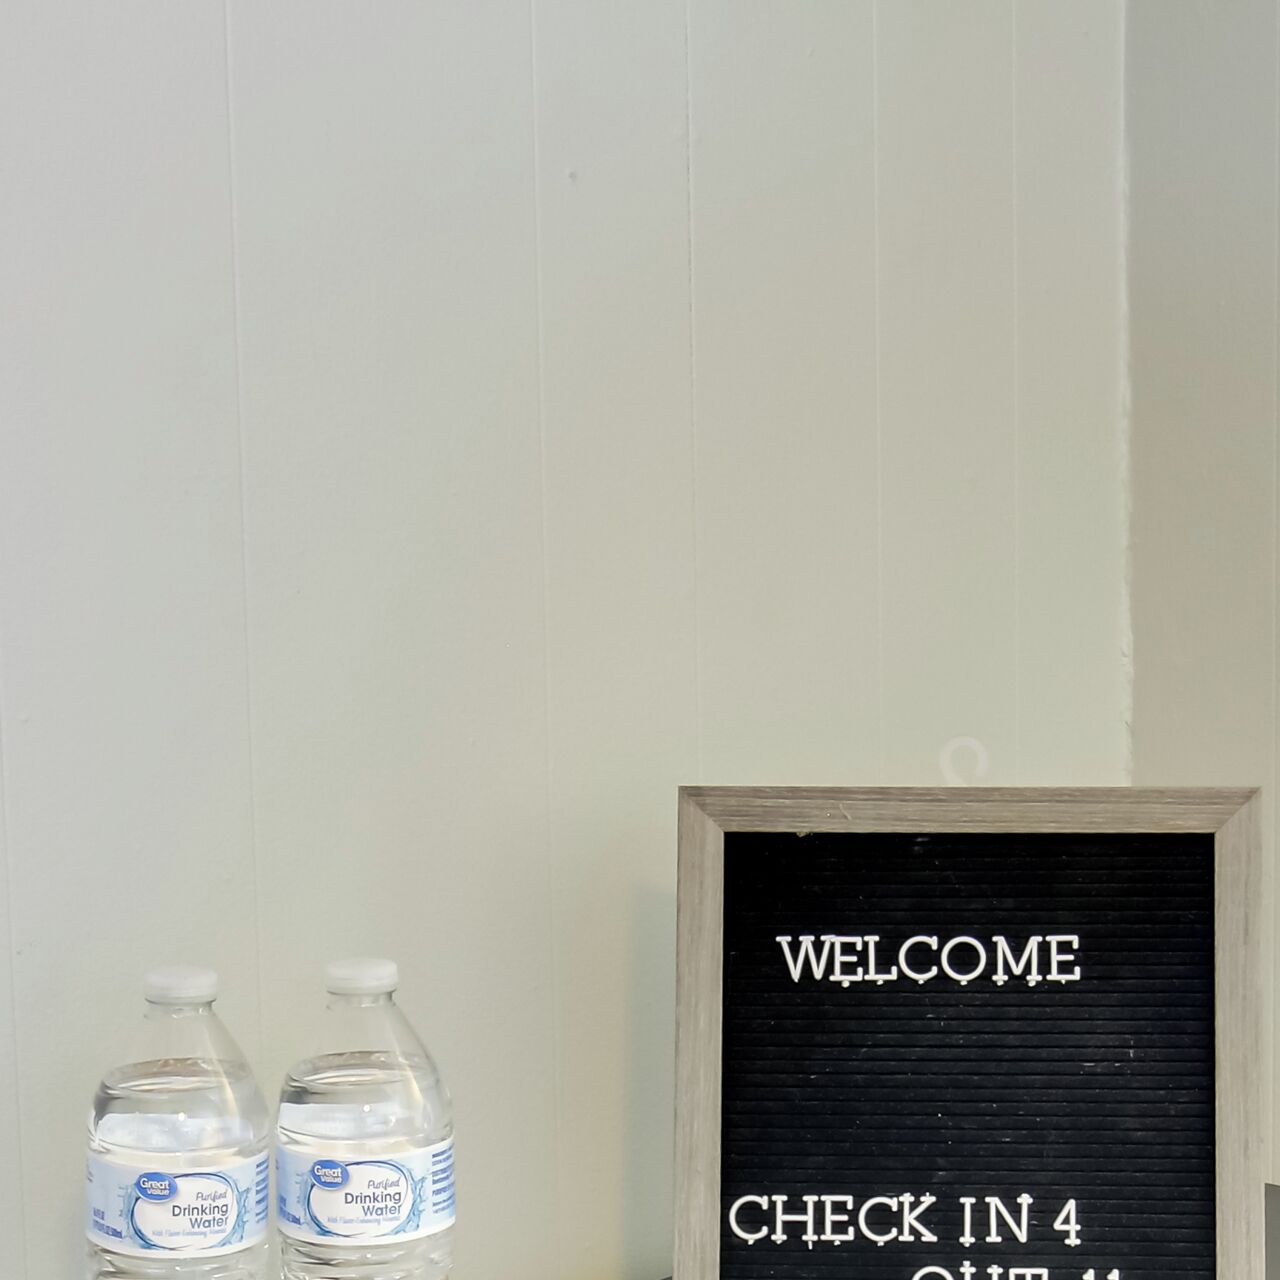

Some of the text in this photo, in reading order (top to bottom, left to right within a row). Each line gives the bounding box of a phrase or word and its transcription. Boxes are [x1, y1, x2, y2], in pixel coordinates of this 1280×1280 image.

[776, 935, 1081, 985] WELCOME
[314, 1165, 342, 1178] Great
[140, 1177, 169, 1190] Great
[321, 1176, 343, 1185] Value
[367, 1177, 401, 1190] Purified
[147, 1188, 170, 1196] Value
[195, 1189, 227, 1202] Purified
[344, 1191, 402, 1205] Drinking
[172, 1203, 229, 1217] Drinking
[361, 1204, 402, 1216] Water
[189, 1216, 229, 1229] Water
[729, 1193, 1081, 1246] CHECK IN 4
